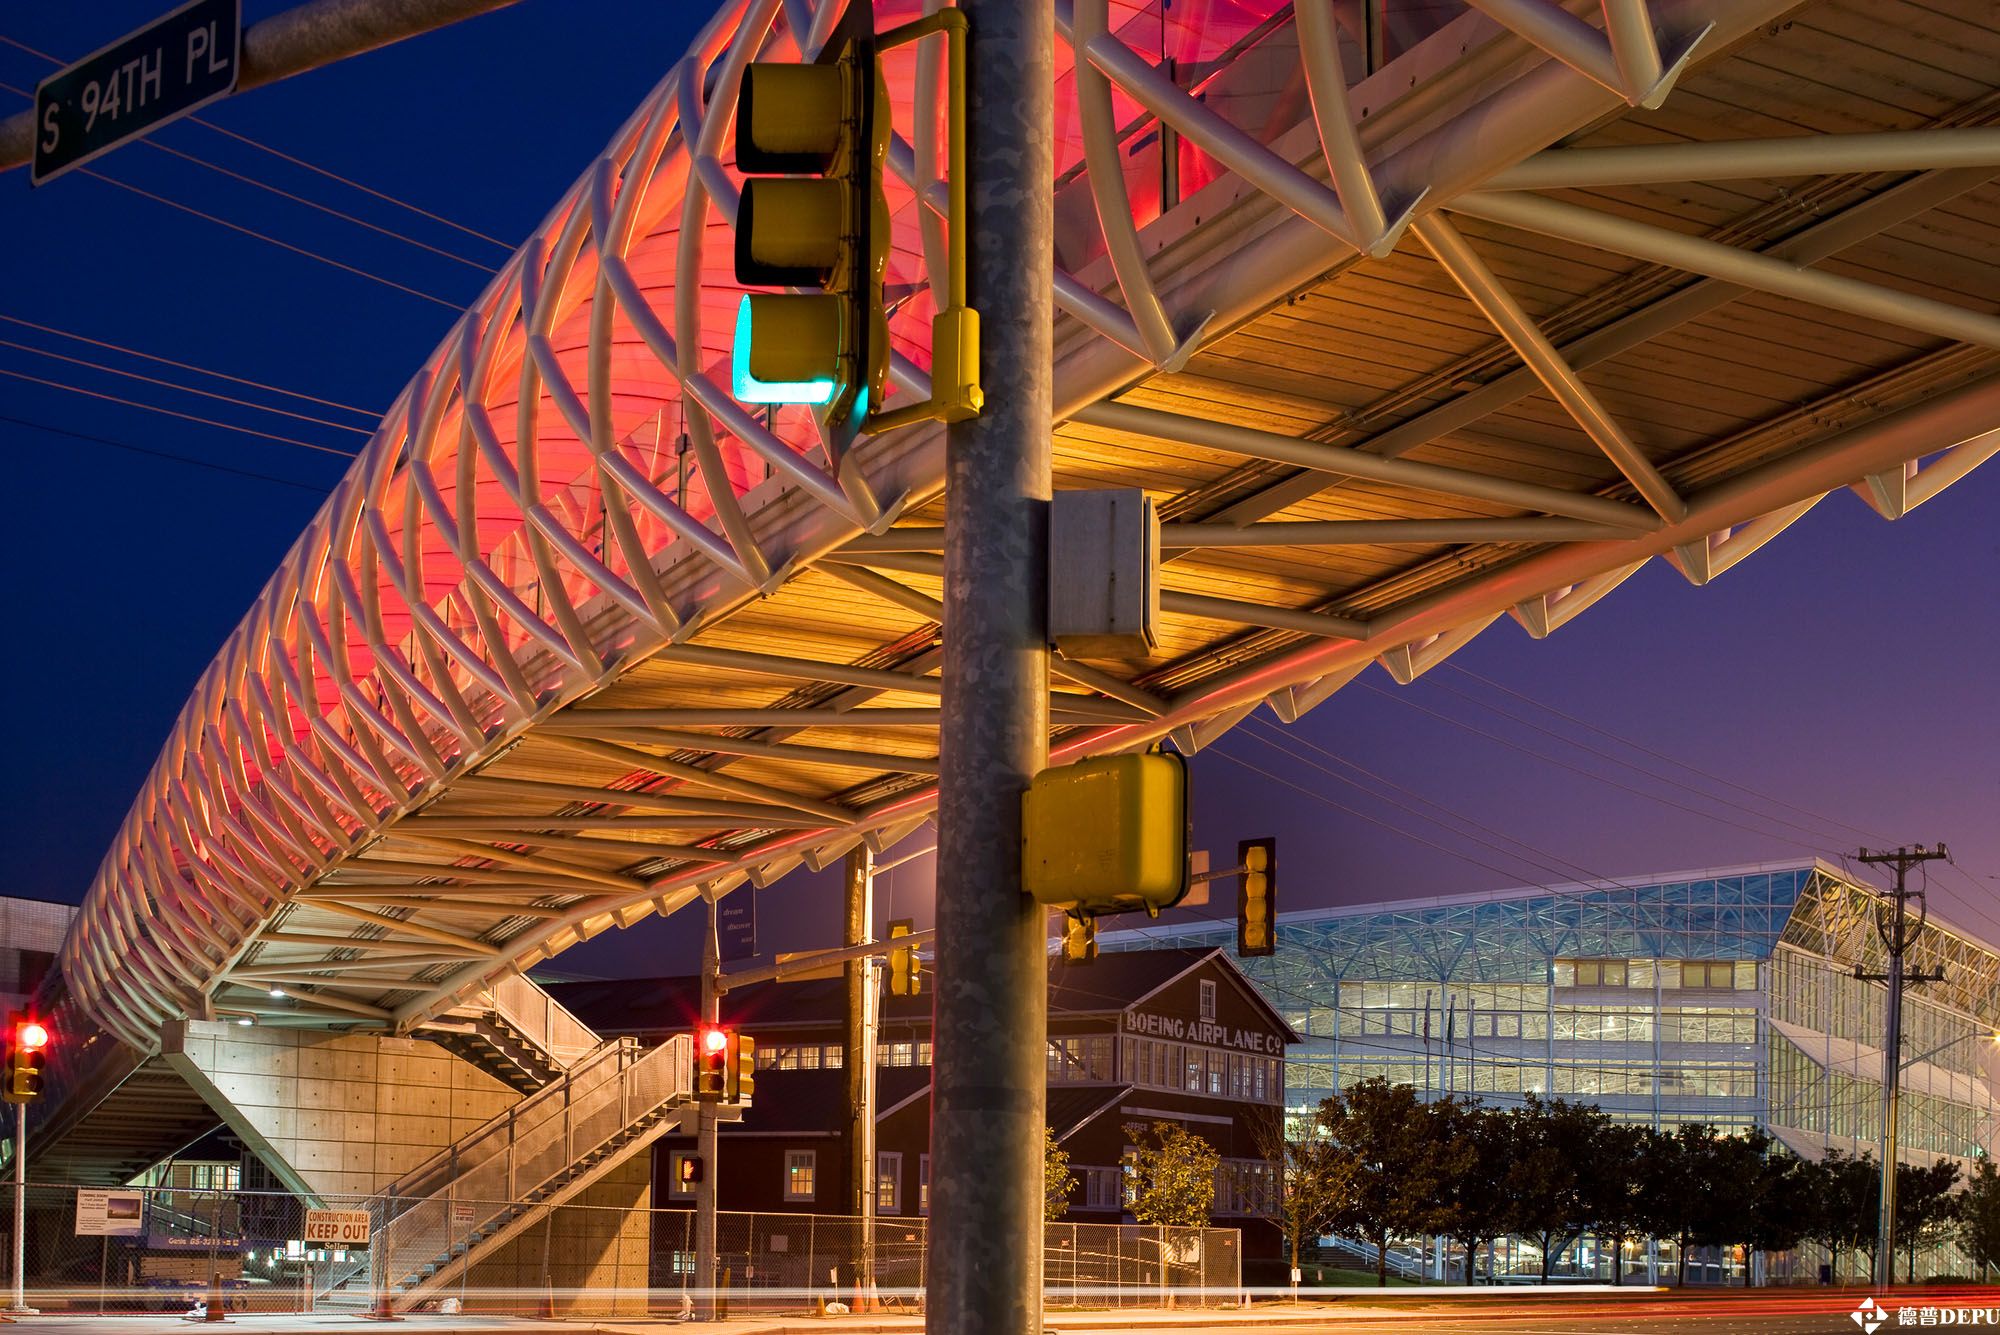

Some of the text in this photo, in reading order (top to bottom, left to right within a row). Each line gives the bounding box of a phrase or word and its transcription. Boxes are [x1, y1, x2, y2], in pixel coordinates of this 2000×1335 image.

[42, 20, 229, 154] S 94TH PL
[1126, 1011, 1184, 1039] BOEING
[1186, 1021, 1264, 1052] AIRPLANE
[308, 1211, 369, 1224] CONSTRUCTION AREA
[307, 1223, 368, 1240] KEEP OUT
[324, 1242, 350, 1250] Sellen
